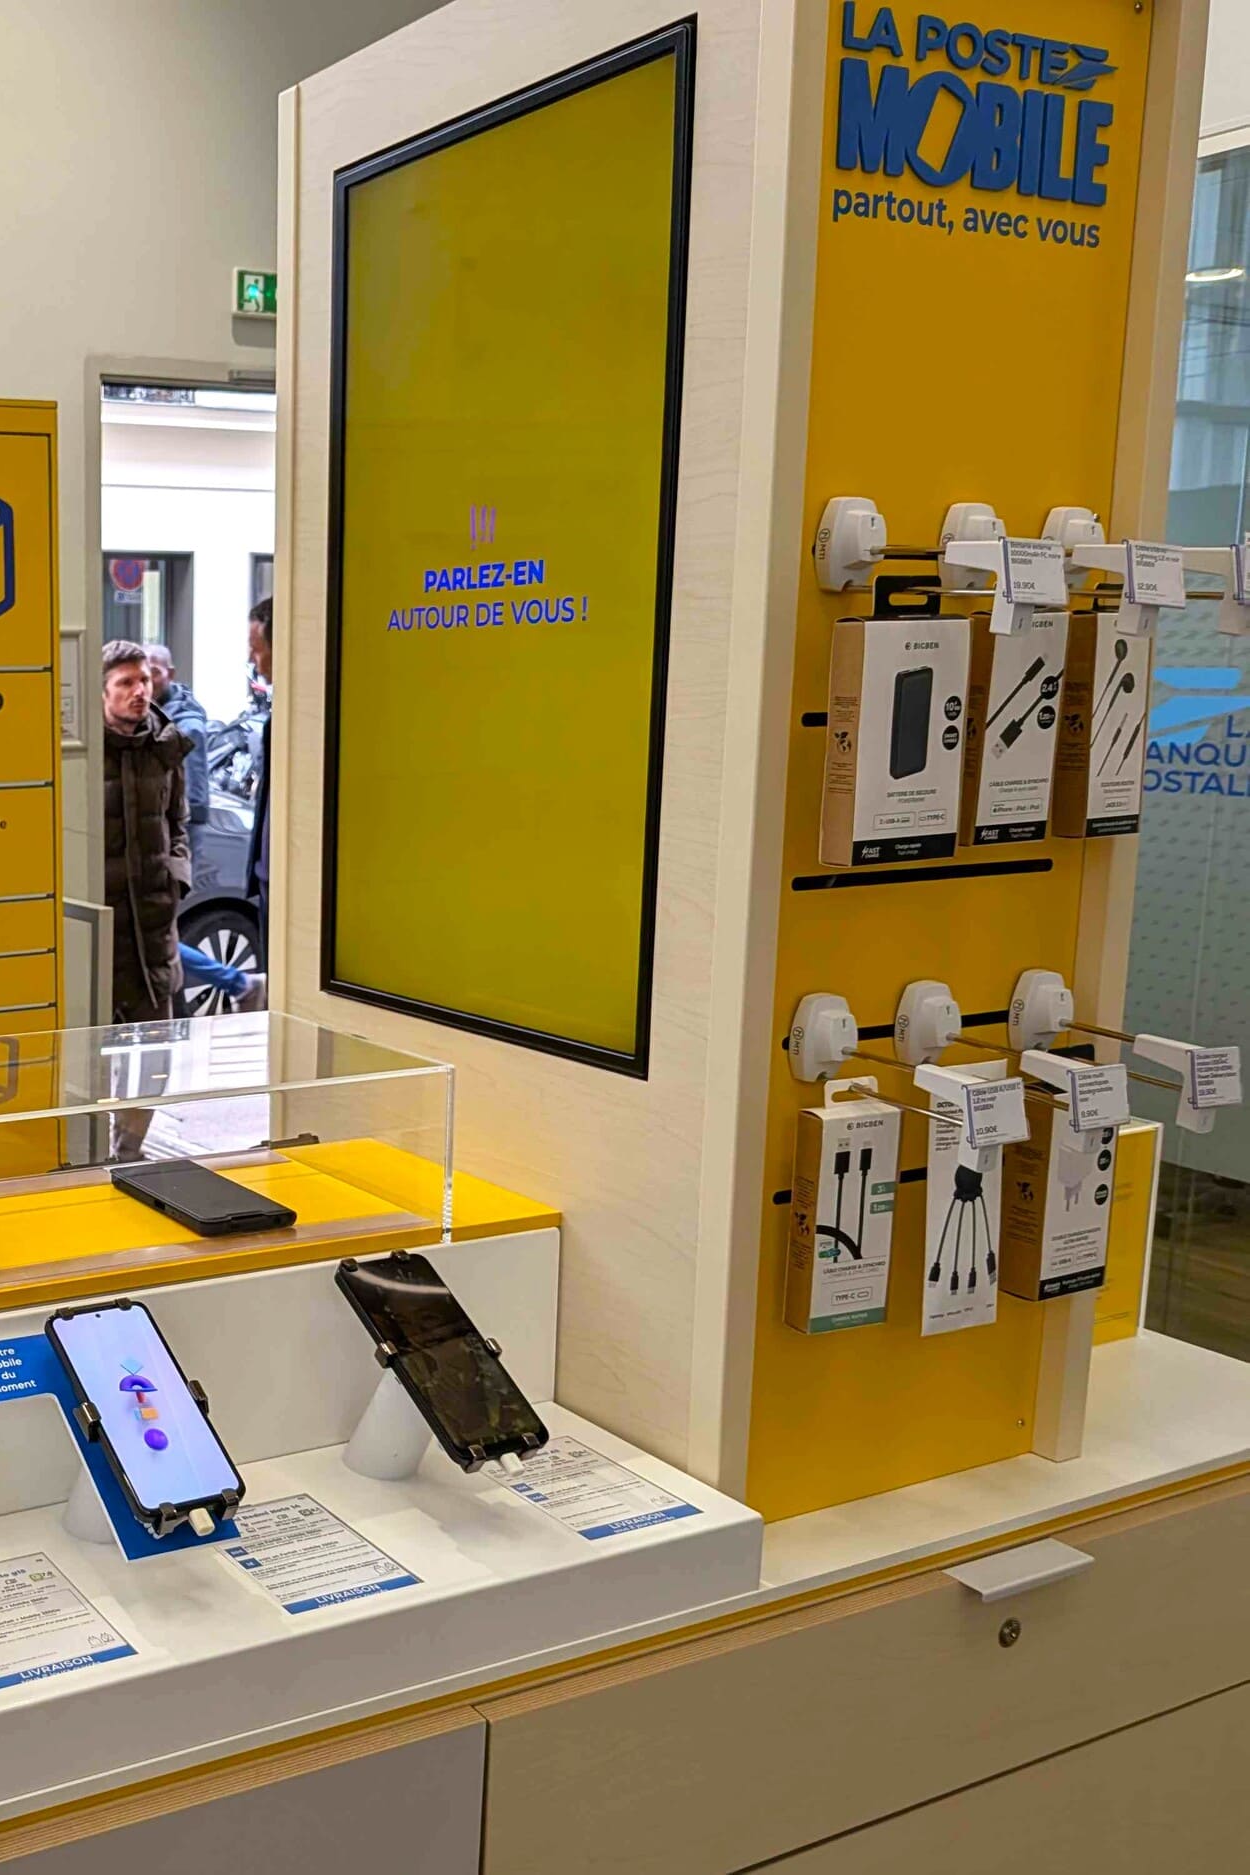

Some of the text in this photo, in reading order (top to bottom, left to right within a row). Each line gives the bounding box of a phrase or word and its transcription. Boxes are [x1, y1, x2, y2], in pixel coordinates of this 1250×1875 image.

[842, 1, 1070, 86] LA POSTE
[836, 57, 1114, 207] MOBILE
[832, 188, 1100, 249] partout, avec vous
[424, 559, 544, 592] PARLEZ-EN
[387, 604, 469, 632] AUTOUR
[475, 602, 504, 627] DE
[510, 597, 574, 624] VOUS
[1146, 741, 1247, 768] ANQU
[1143, 769, 1250, 797] OSTAL
[835, 1293, 855, 1301] TYPE-C
[1, 1371, 16, 1380] du
[608, 1511, 666, 1529] LIVRAISON
[315, 1583, 381, 1604] LIVRAISON
[20, 1655, 94, 1679] LIVRAISON
